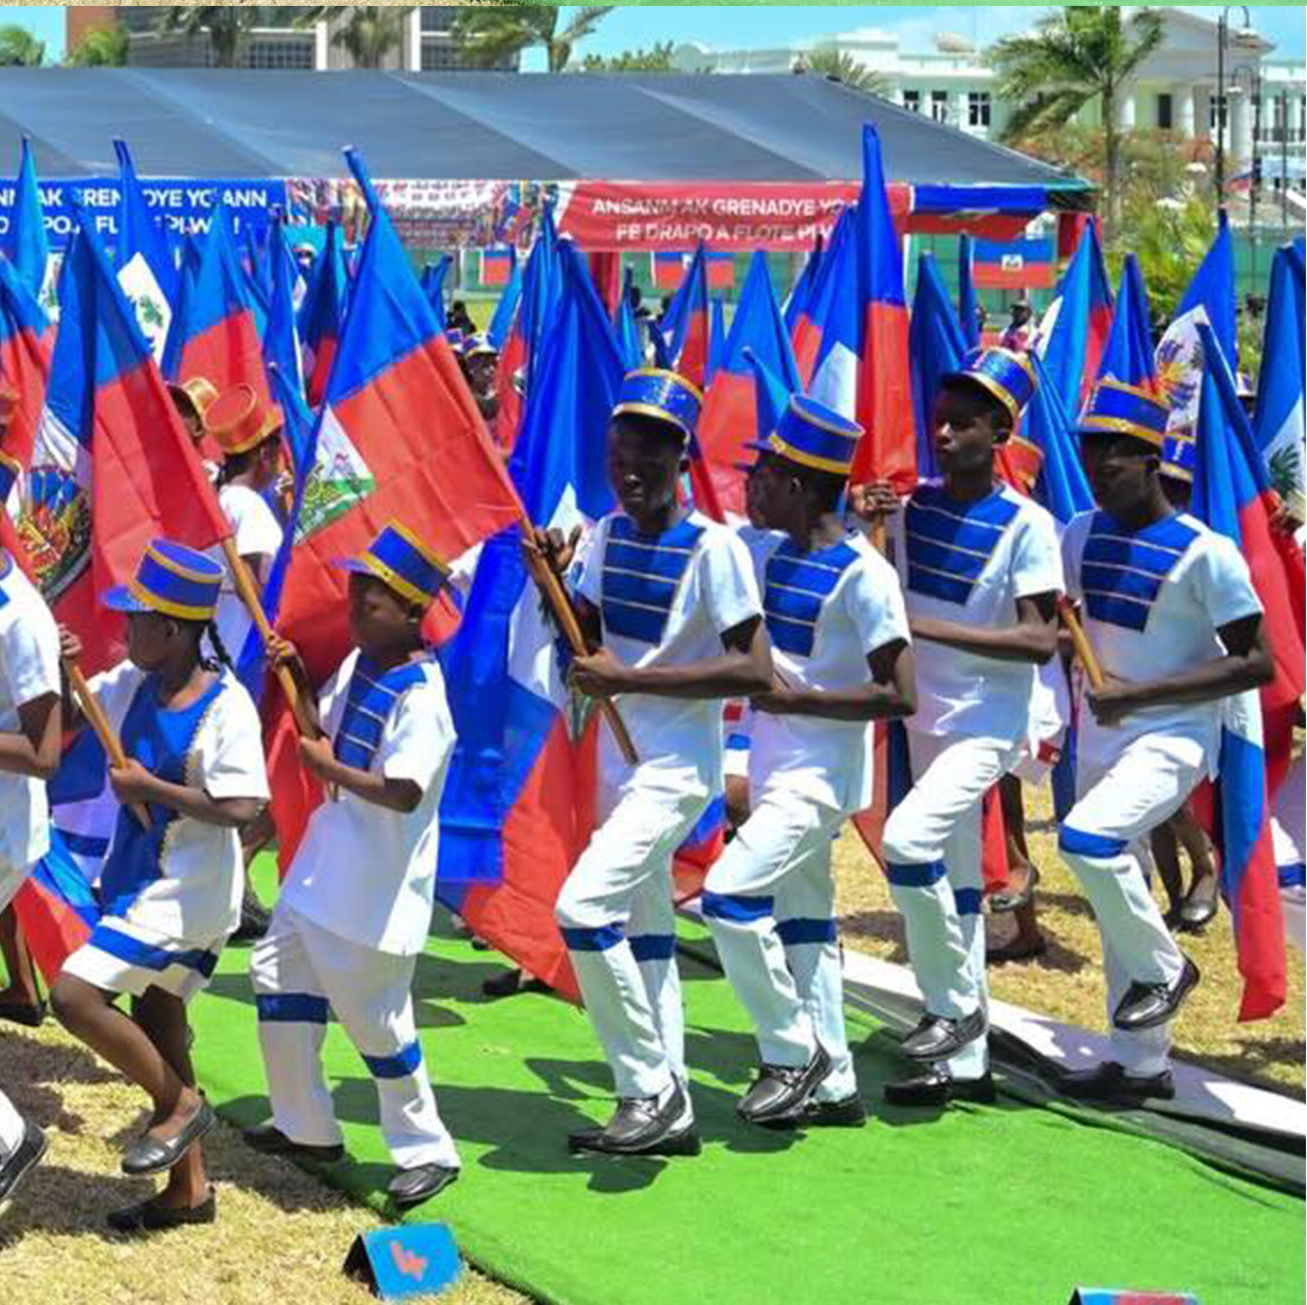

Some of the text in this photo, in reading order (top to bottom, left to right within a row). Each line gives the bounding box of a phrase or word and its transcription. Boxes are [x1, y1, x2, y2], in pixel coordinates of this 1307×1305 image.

[223, 189, 266, 207] ANN
[712, 198, 815, 216] GRENADYE
[646, 223, 713, 240] DRAPO
